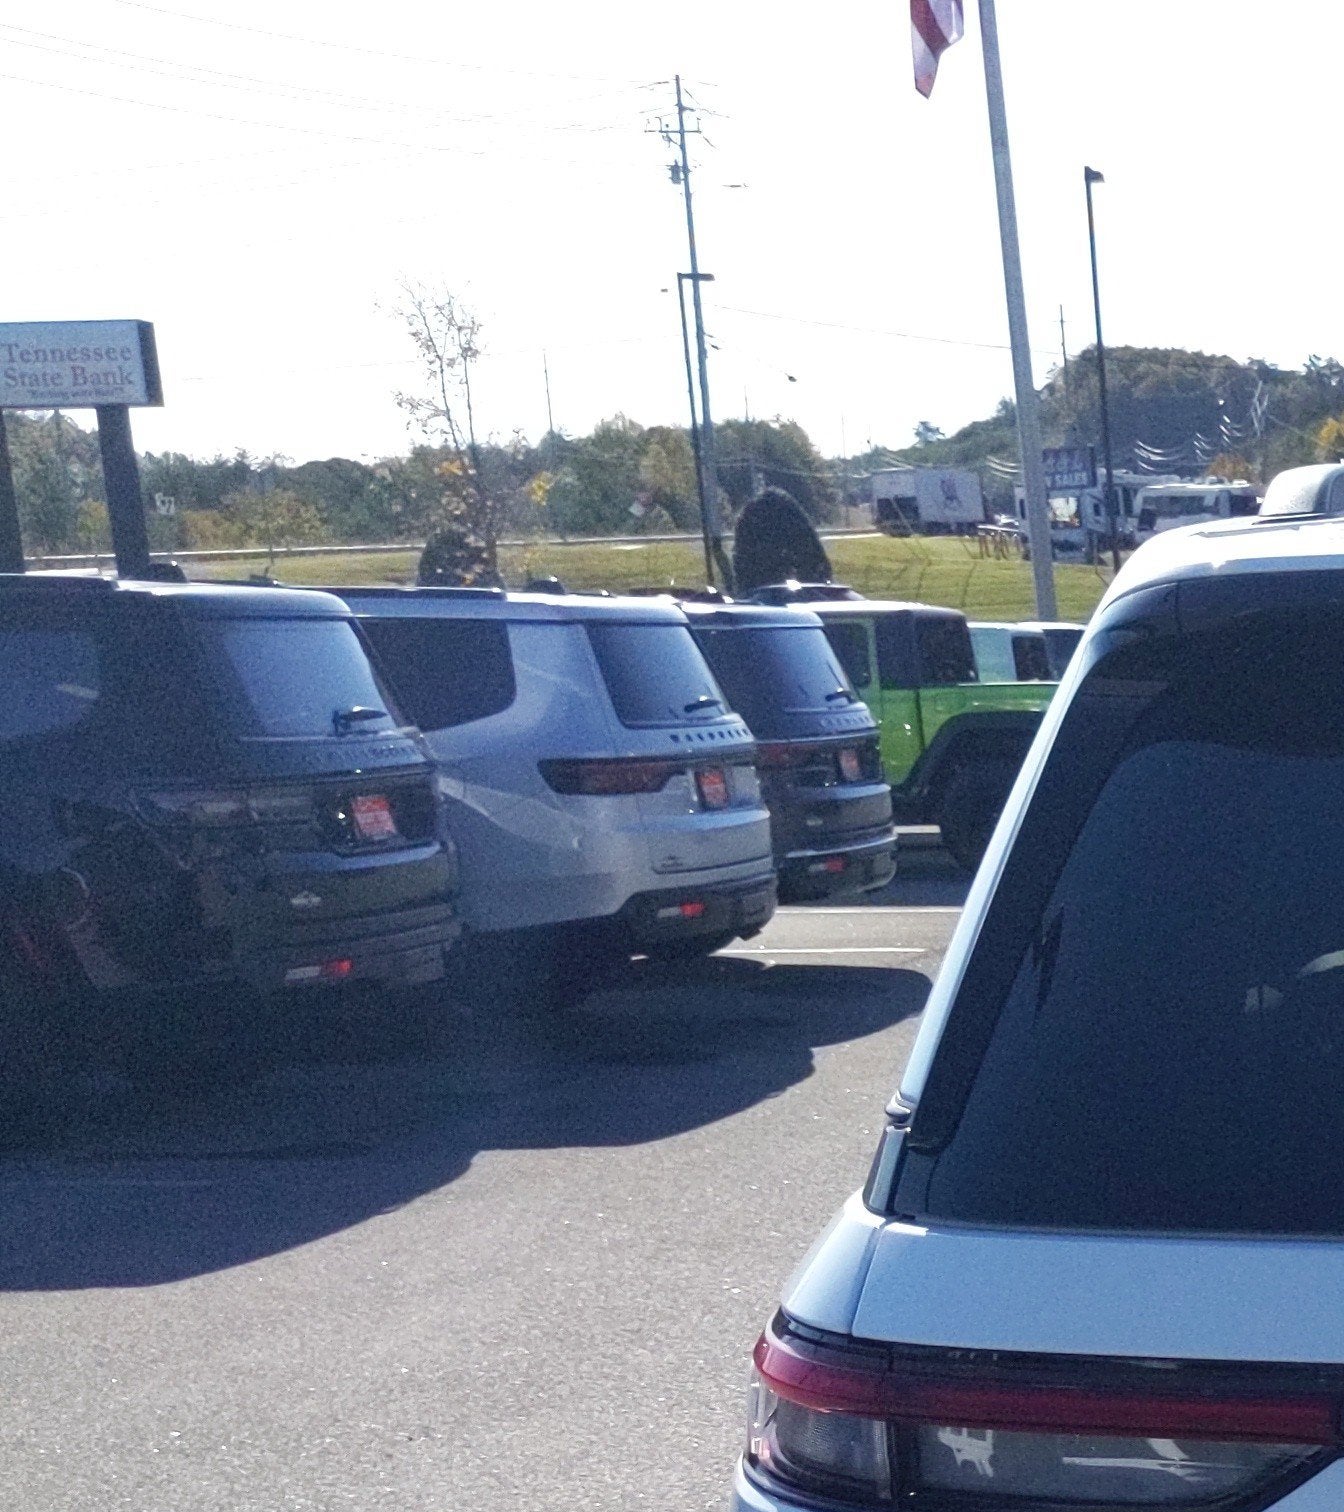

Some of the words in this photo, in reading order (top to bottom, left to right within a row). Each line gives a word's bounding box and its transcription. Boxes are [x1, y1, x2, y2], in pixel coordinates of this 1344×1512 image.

[1, 343, 133, 363] Tennessee
[4, 366, 64, 388] State
[71, 365, 136, 387] Bank
